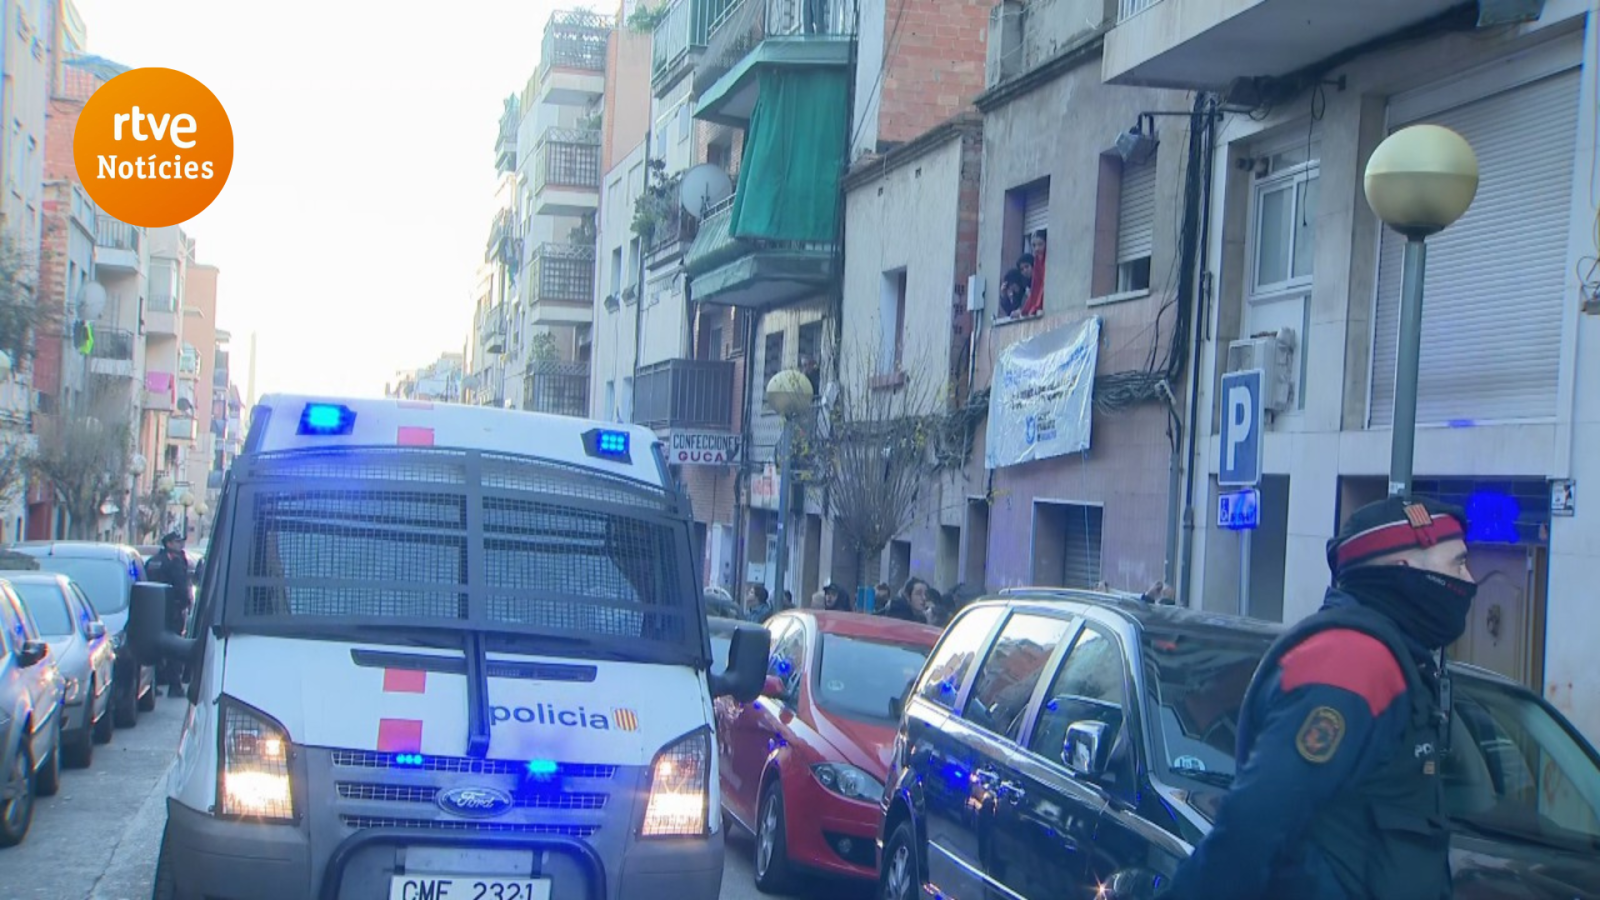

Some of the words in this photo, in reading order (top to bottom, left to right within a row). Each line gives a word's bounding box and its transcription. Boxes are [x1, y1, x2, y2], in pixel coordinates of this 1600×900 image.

[1226, 386, 1252, 471] P
[489, 703, 610, 731] policia
[456, 791, 496, 809] Ford
[473, 882, 533, 900] 2321
